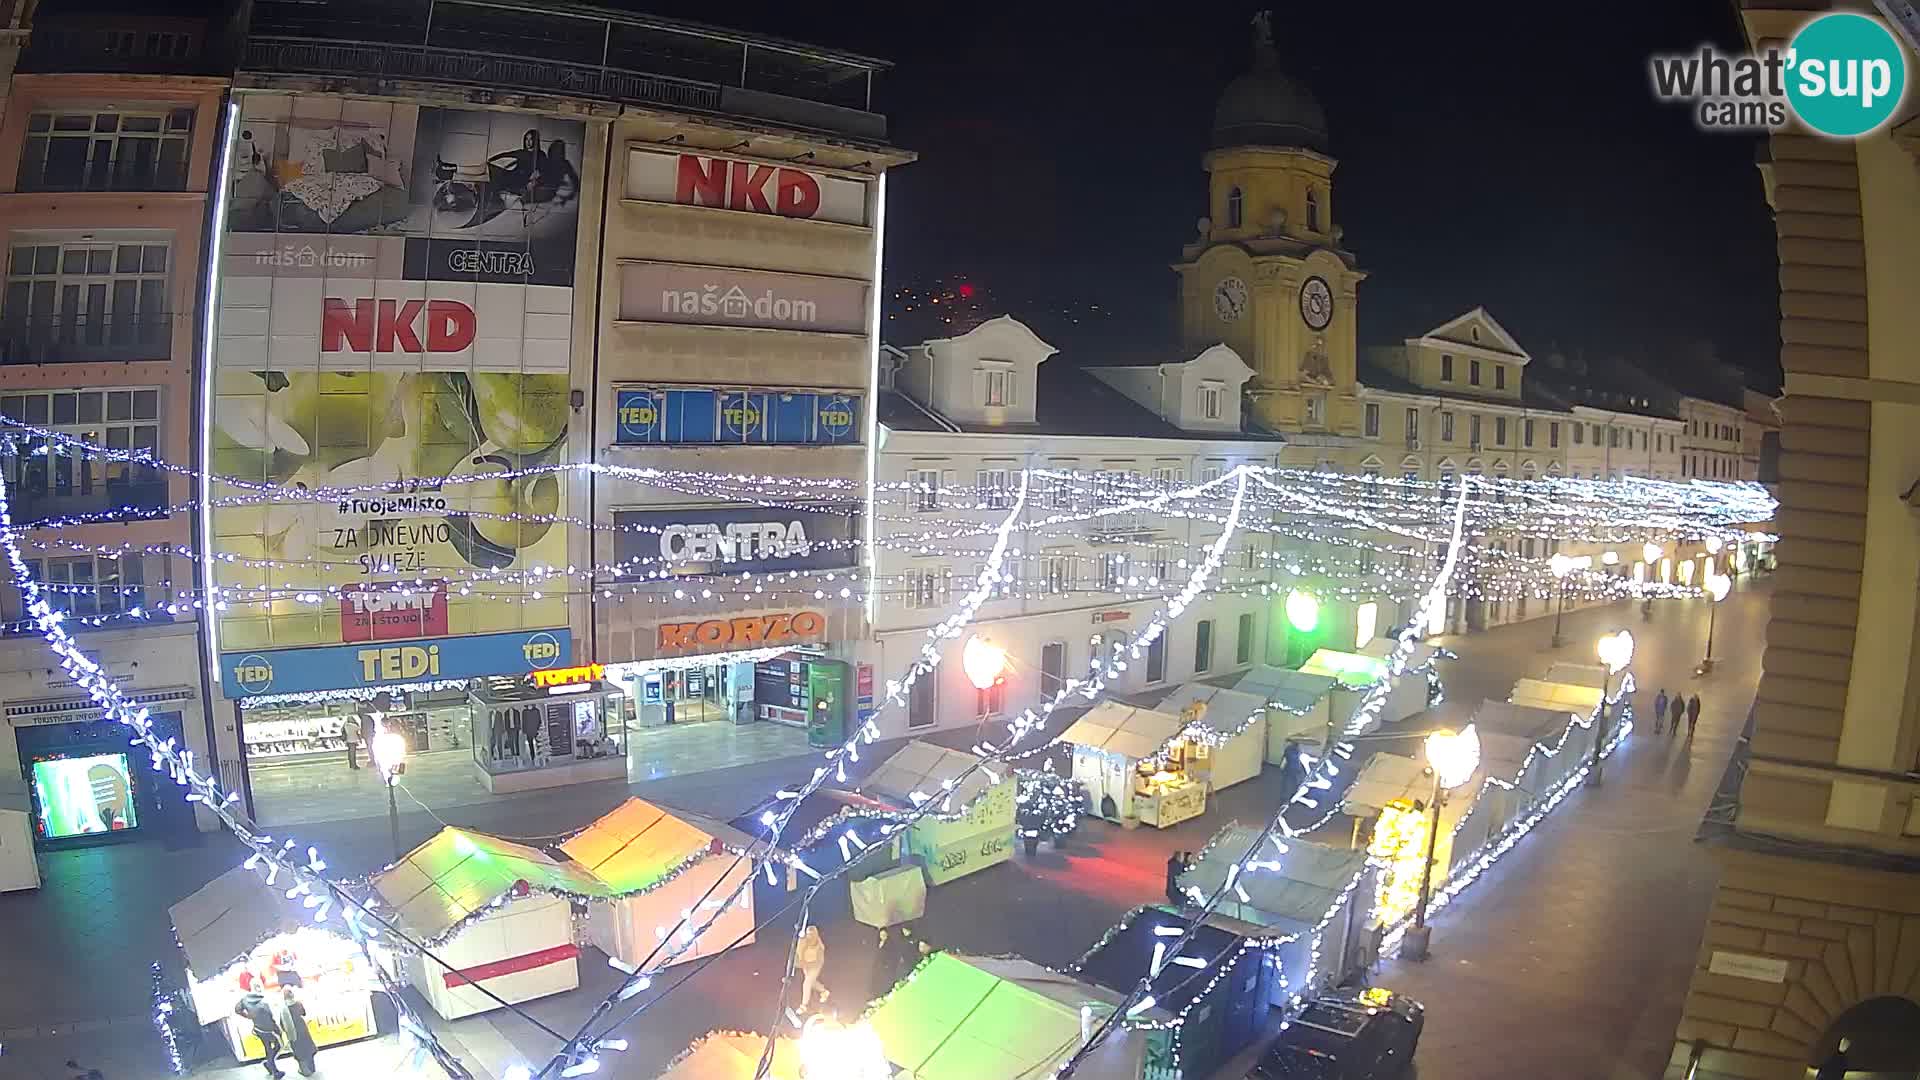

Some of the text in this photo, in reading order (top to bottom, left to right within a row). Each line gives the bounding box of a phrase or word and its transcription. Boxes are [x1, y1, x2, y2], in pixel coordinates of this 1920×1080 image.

[675, 154, 822, 219] NKD
[319, 243, 366, 268] dom
[448, 249, 535, 275] CENTRA
[661, 284, 817, 322] naš dom
[321, 297, 477, 354] NKD
[333, 522, 450, 548] ZA DNEVNO
[660, 521, 810, 562] CENTRA
[658, 611, 826, 650] KORZO
[358, 644, 440, 682] TEDi
[533, 663, 606, 687] TOMMY
